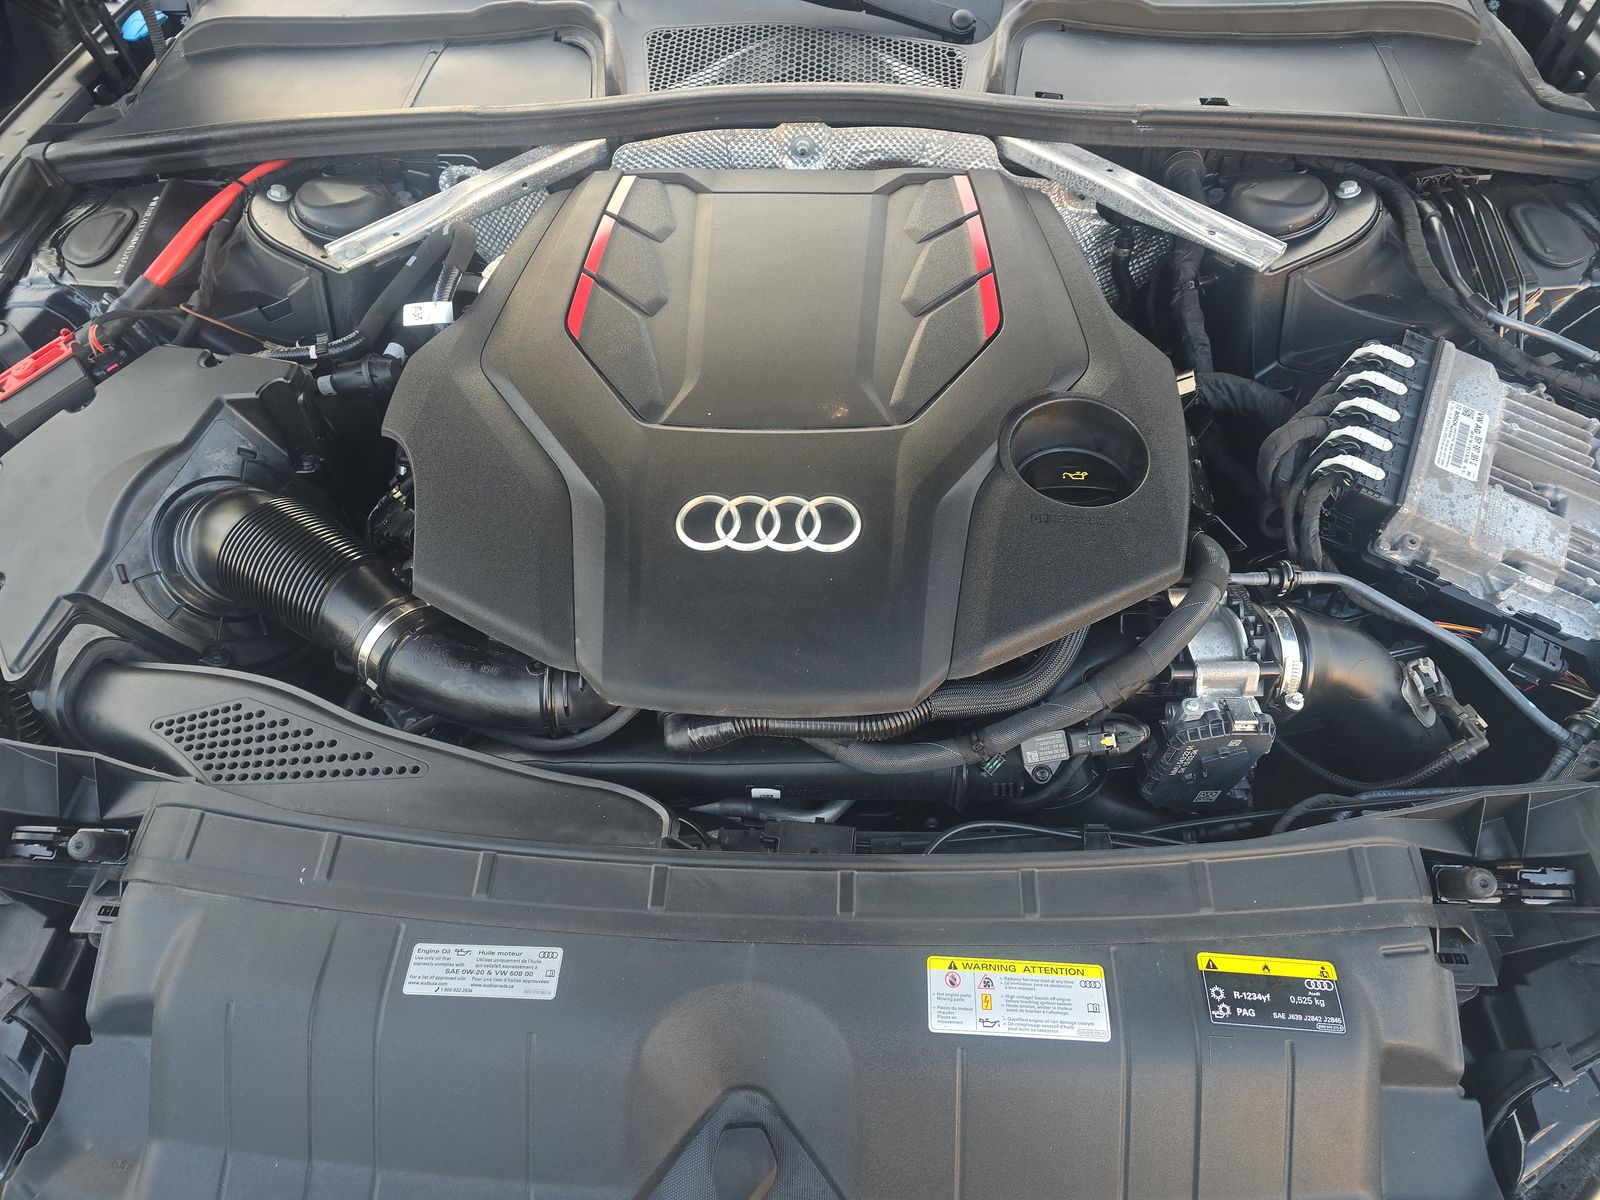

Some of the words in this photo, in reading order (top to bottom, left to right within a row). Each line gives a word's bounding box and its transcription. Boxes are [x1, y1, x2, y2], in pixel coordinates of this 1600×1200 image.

[1452, 410, 1460, 427] BOSCH
[1476, 412, 1485, 424] VW
[1474, 423, 1482, 434] AG
[961, 961, 1016, 972] WARNING
[1022, 964, 1084, 976] ATTENTION
[1232, 991, 1271, 1003] R-1234yf
[1289, 995, 1313, 1005] 0,525
[1314, 997, 1325, 1007] kg
[1236, 1007, 1256, 1017] PAG
